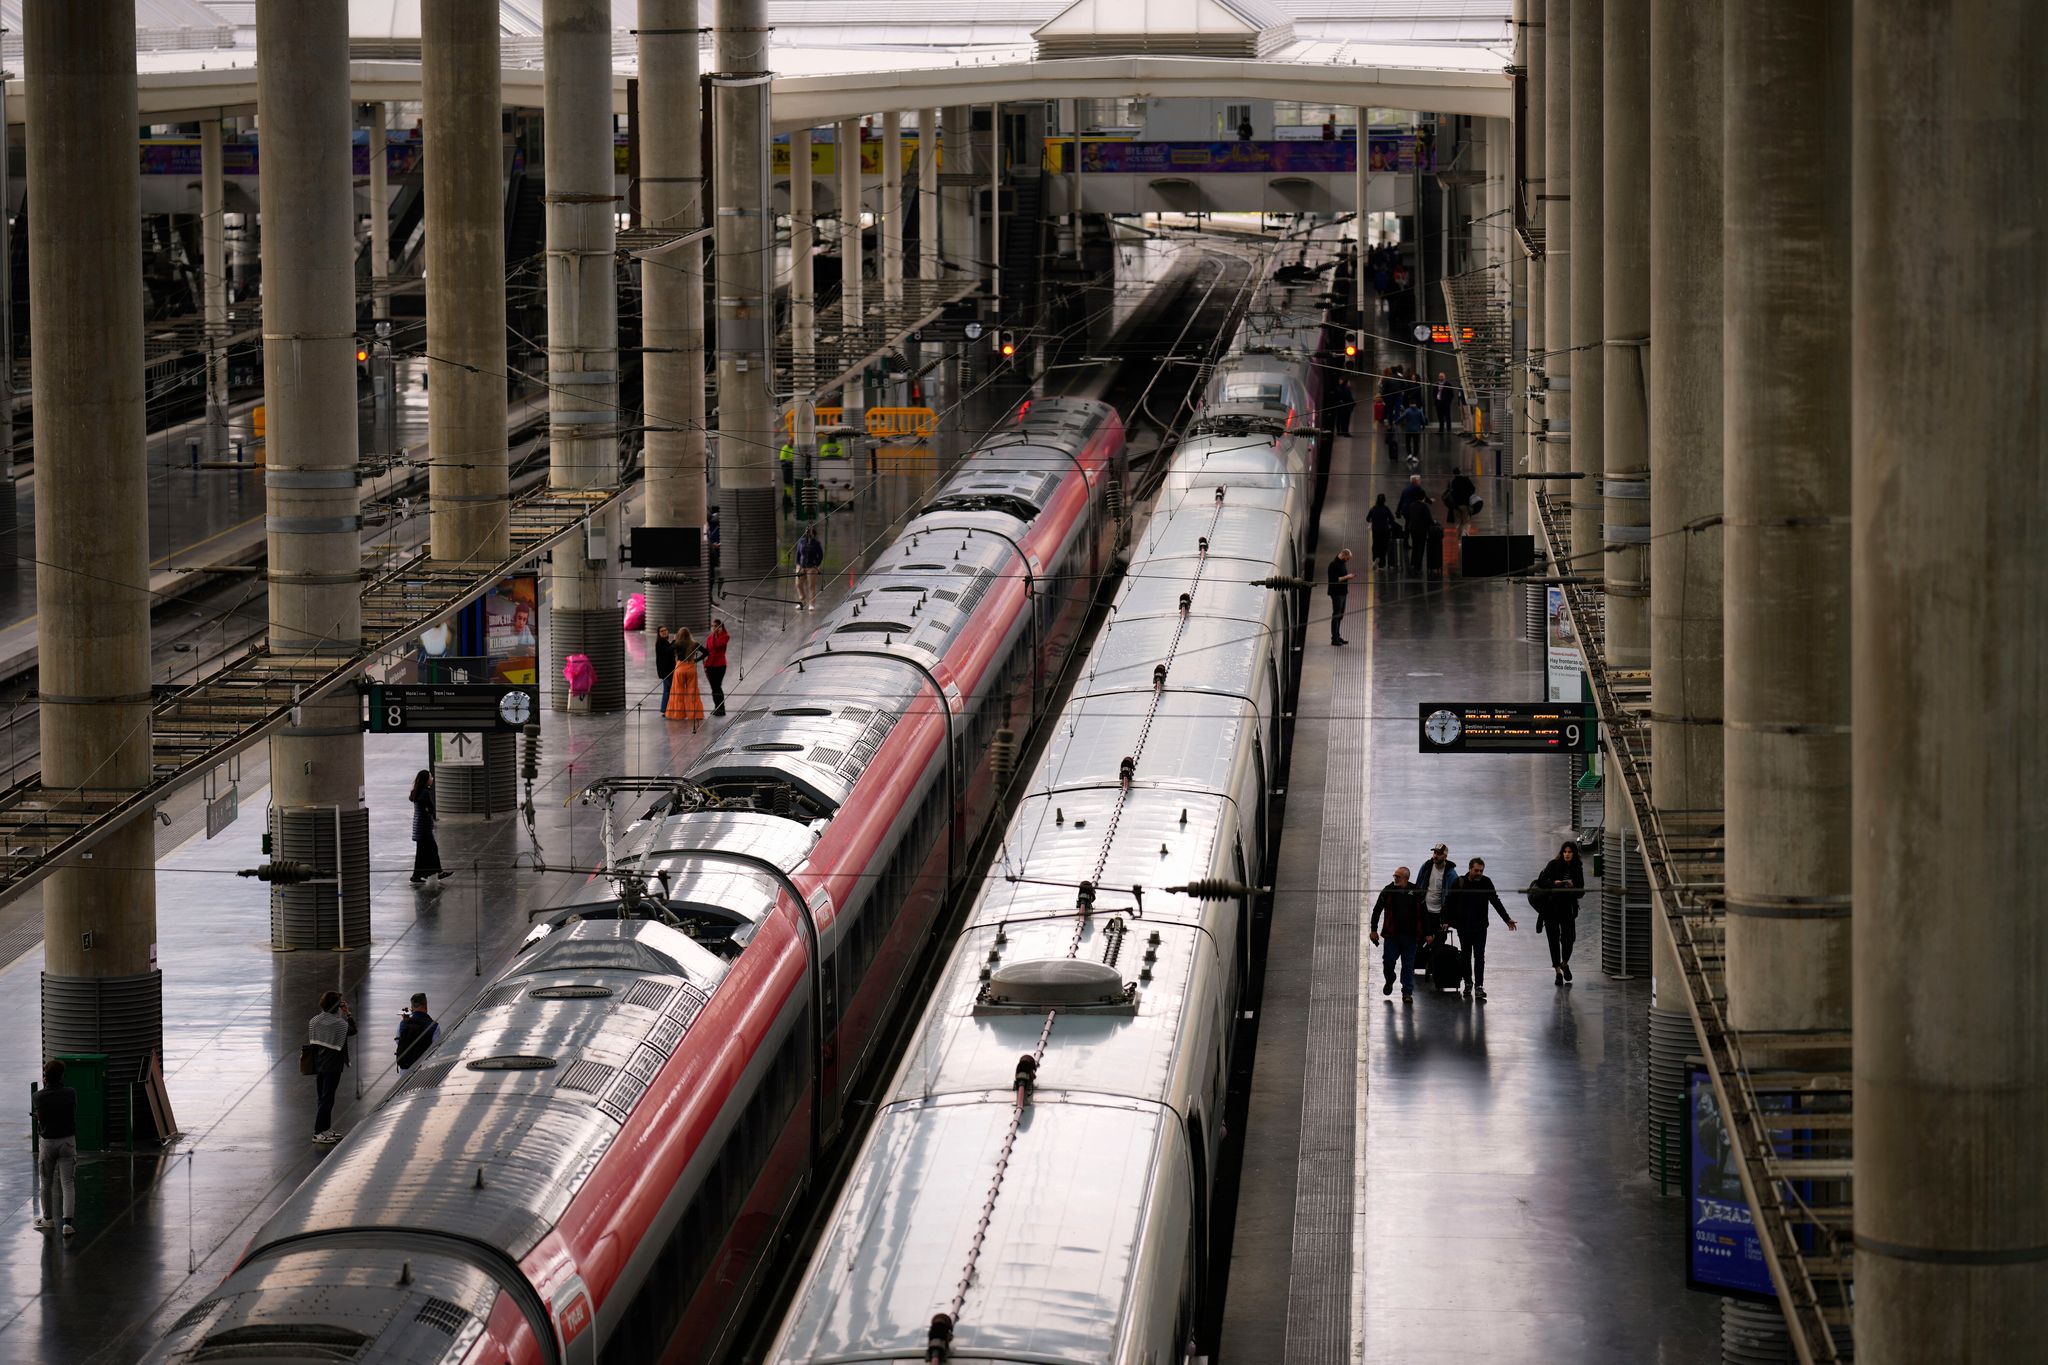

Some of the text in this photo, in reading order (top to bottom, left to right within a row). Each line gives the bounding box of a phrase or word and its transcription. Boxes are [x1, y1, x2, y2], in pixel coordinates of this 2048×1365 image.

[387, 705, 402, 727] 8
[1565, 724, 1580, 747] 9
[1696, 1198, 1754, 1225] MEGAD
